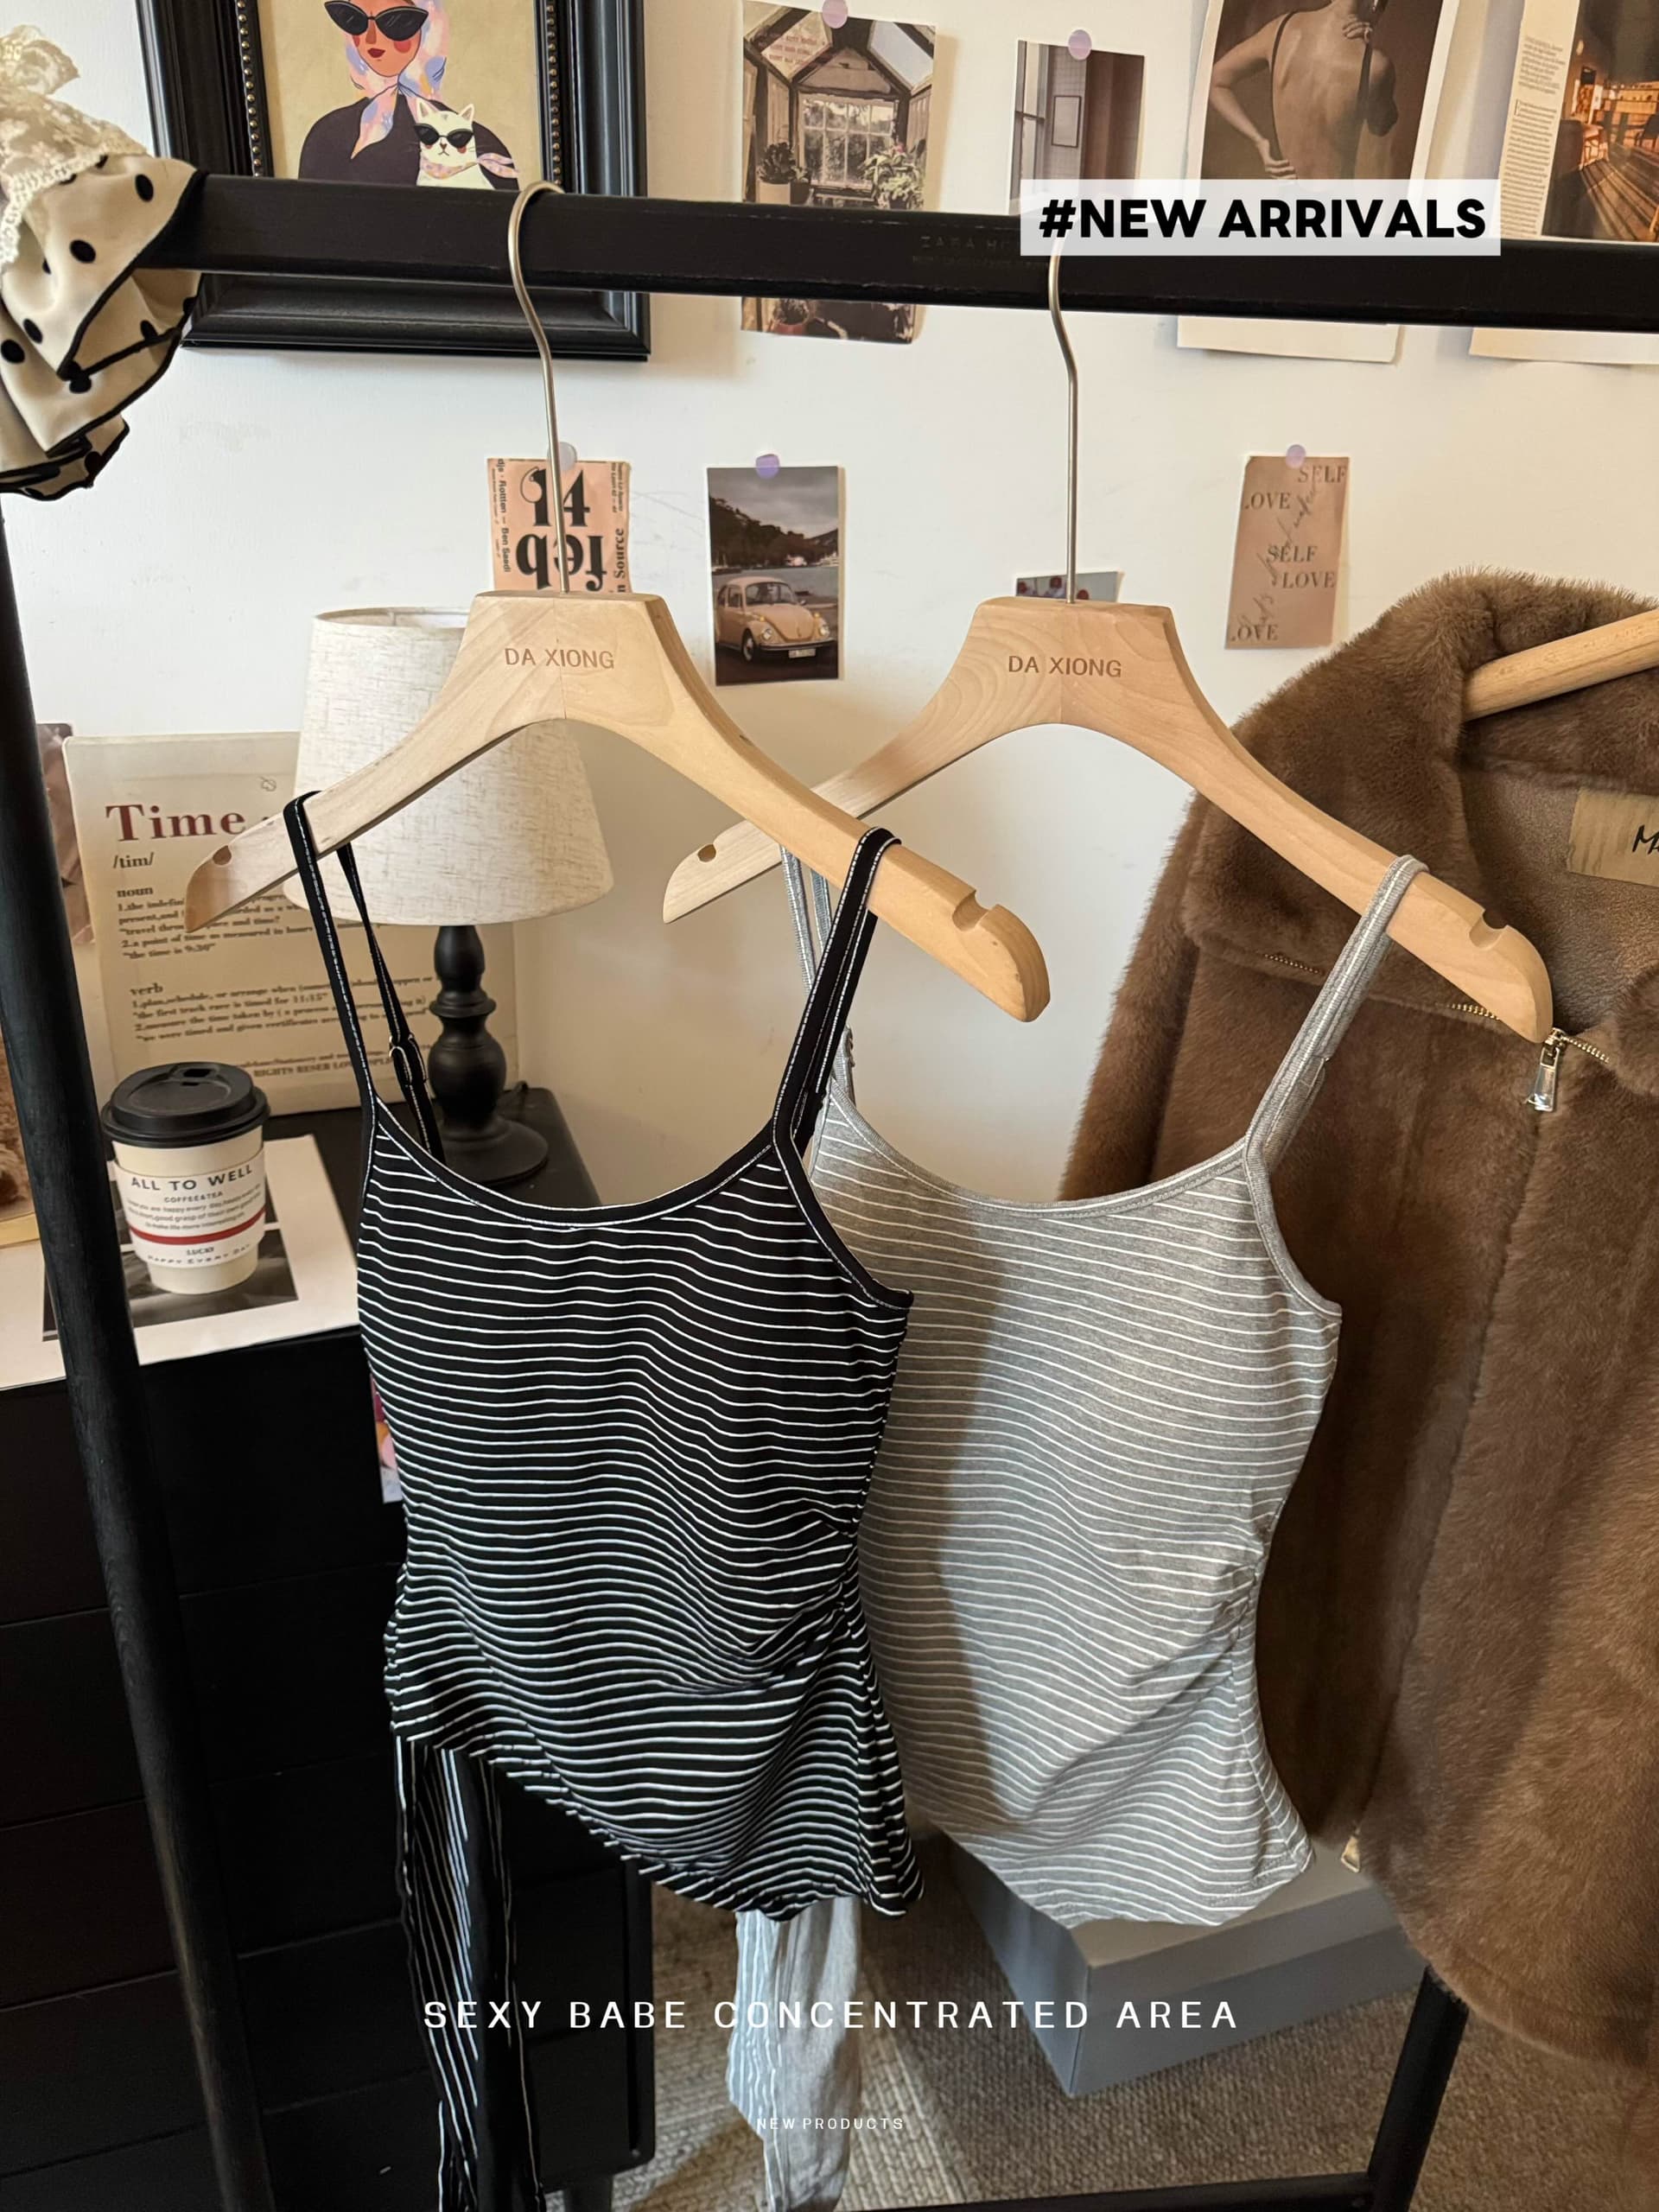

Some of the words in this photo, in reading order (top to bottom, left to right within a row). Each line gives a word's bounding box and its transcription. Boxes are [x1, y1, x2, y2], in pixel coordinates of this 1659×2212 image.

[1298, 465, 1347, 483] SELF
[519, 467, 591, 526] 14
[1244, 492, 1291, 510] OVE
[516, 533, 607, 592] feb
[613, 528, 625, 579] Source
[1267, 545, 1318, 563] SELF
[1282, 571, 1336, 589] LOVE
[1230, 624, 1279, 641] OVE
[505, 647, 536, 666] DA
[545, 649, 614, 669] XIONG
[1008, 655, 1039, 673] DA
[1049, 657, 1122, 678] XIONG
[105, 804, 246, 842] Time
[113, 852, 154, 868] /tim/
[117, 887, 153, 898] noun
[130, 982, 162, 995] verb
[131, 1177, 161, 1191] ALL
[168, 1179, 197, 1191] TO
[207, 1165, 252, 1187] WELL
